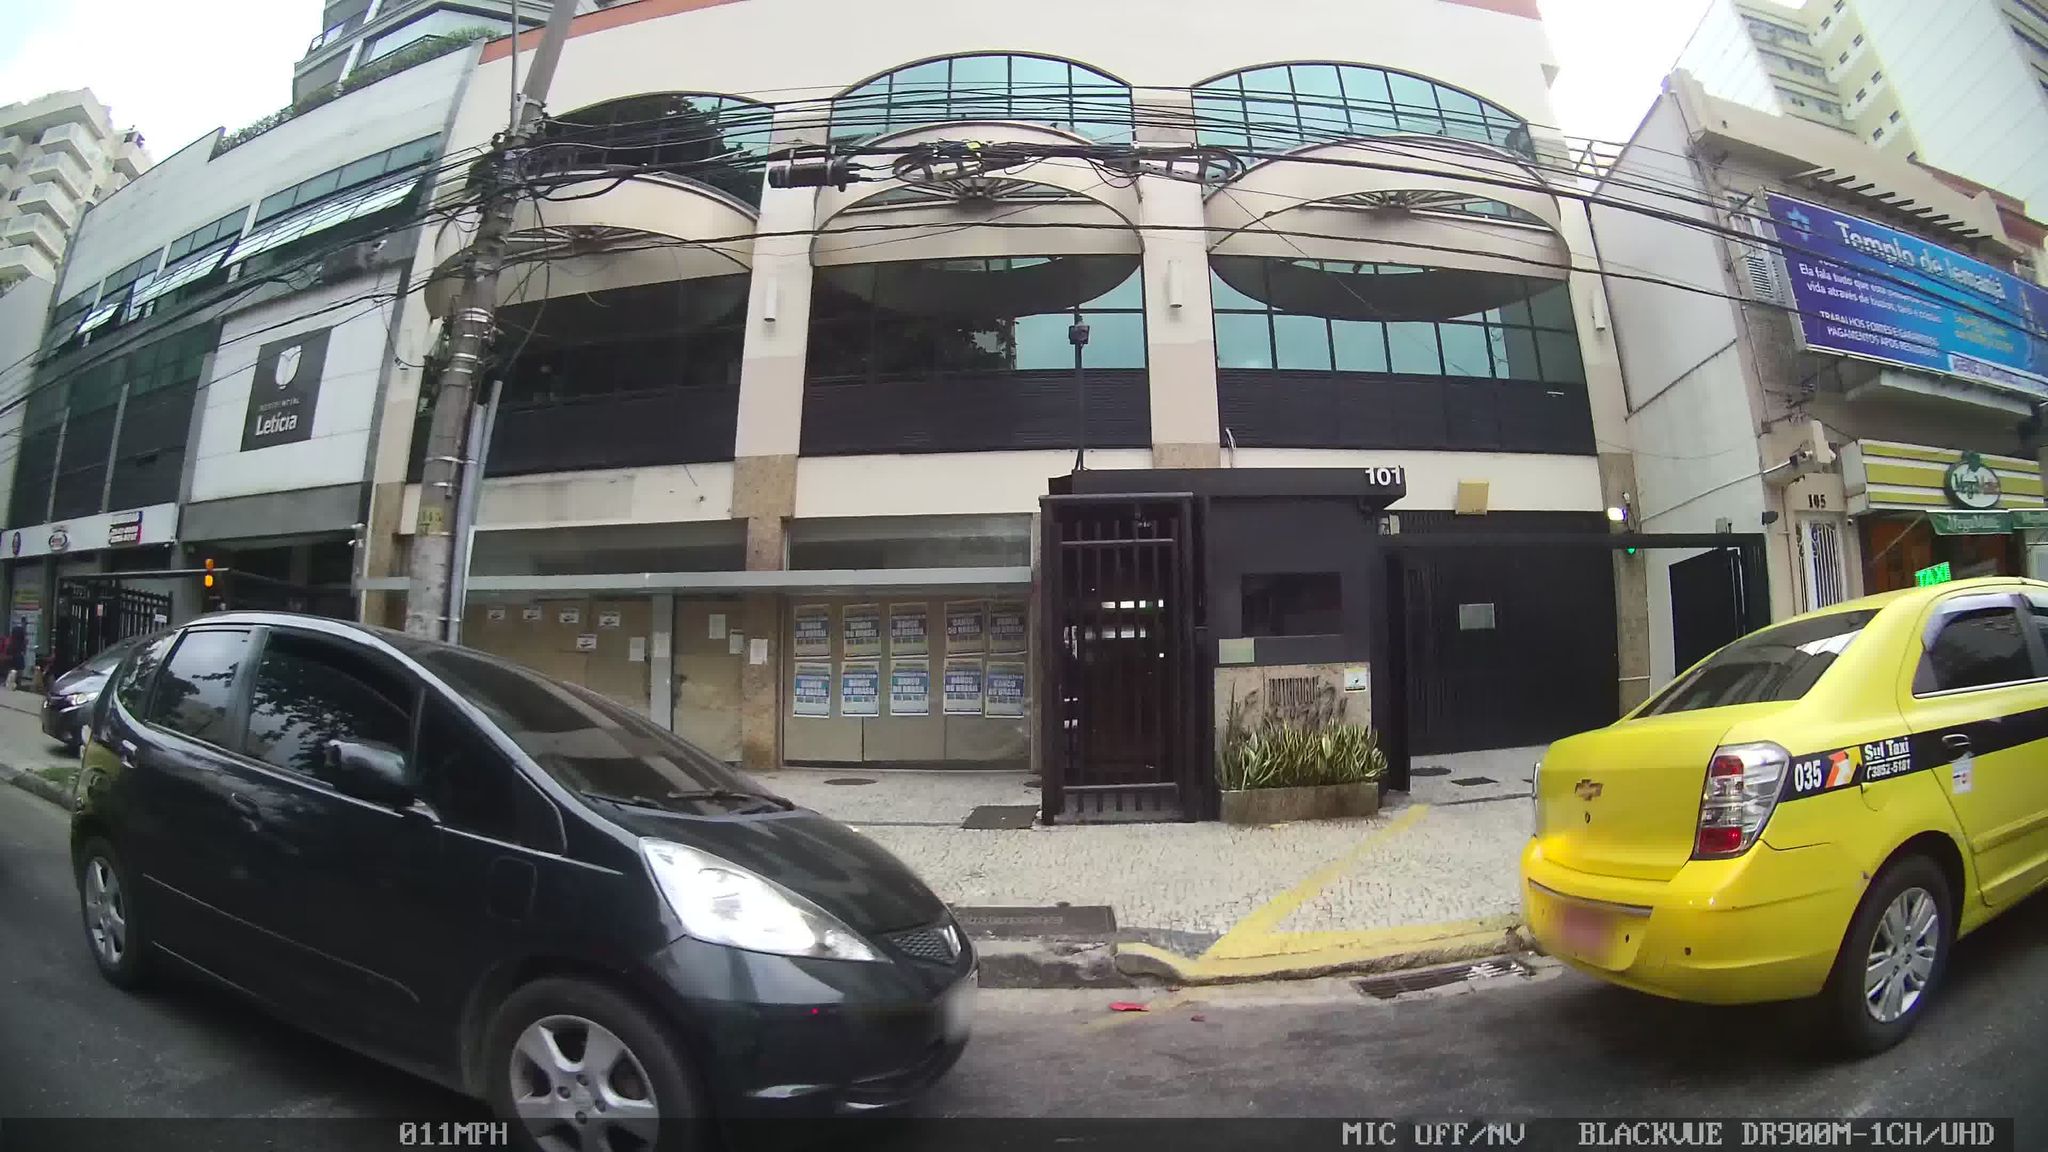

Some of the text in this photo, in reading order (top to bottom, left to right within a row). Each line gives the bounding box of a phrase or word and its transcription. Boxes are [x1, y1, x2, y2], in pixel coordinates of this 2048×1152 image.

[1833, 220, 1915, 266] Templo
[1799, 262, 1814, 277] Ela
[1815, 266, 1832, 281] fala
[1807, 280, 1827, 294] vida
[255, 411, 298, 436] Letícia
[1365, 465, 1401, 486] 101
[1915, 562, 1951, 588] TAXI
[1864, 737, 1909, 760] Sul Taxi
[1794, 759, 1822, 792] 035
